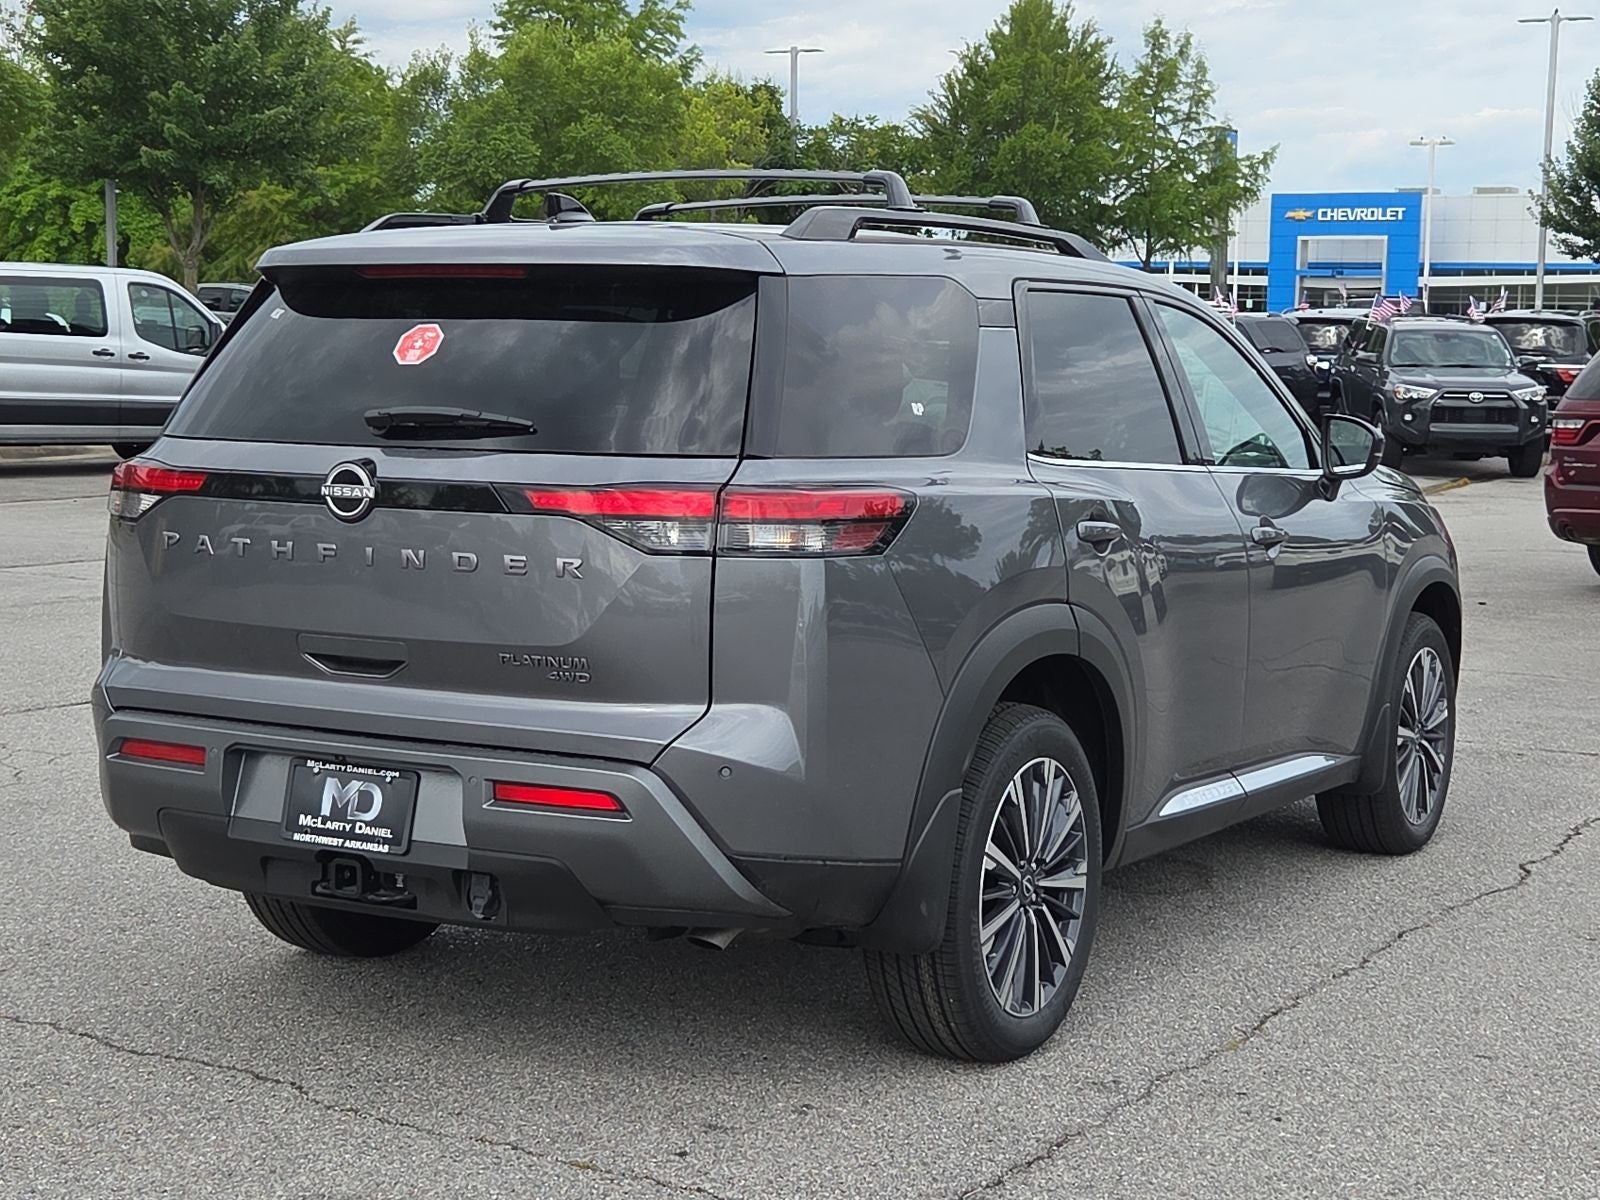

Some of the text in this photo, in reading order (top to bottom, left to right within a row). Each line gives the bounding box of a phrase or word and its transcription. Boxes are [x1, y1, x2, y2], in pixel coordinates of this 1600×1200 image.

[1317, 207, 1406, 221] CHEVROLET
[320, 485, 375, 499] NISSAN
[162, 530, 585, 581] PATHFINDER
[498, 652, 590, 670] PLATINUM
[546, 670, 592, 683] 4WD
[355, 821, 393, 839] DANIEL
[293, 832, 390, 853] NORTHWEST ARKANSAS
